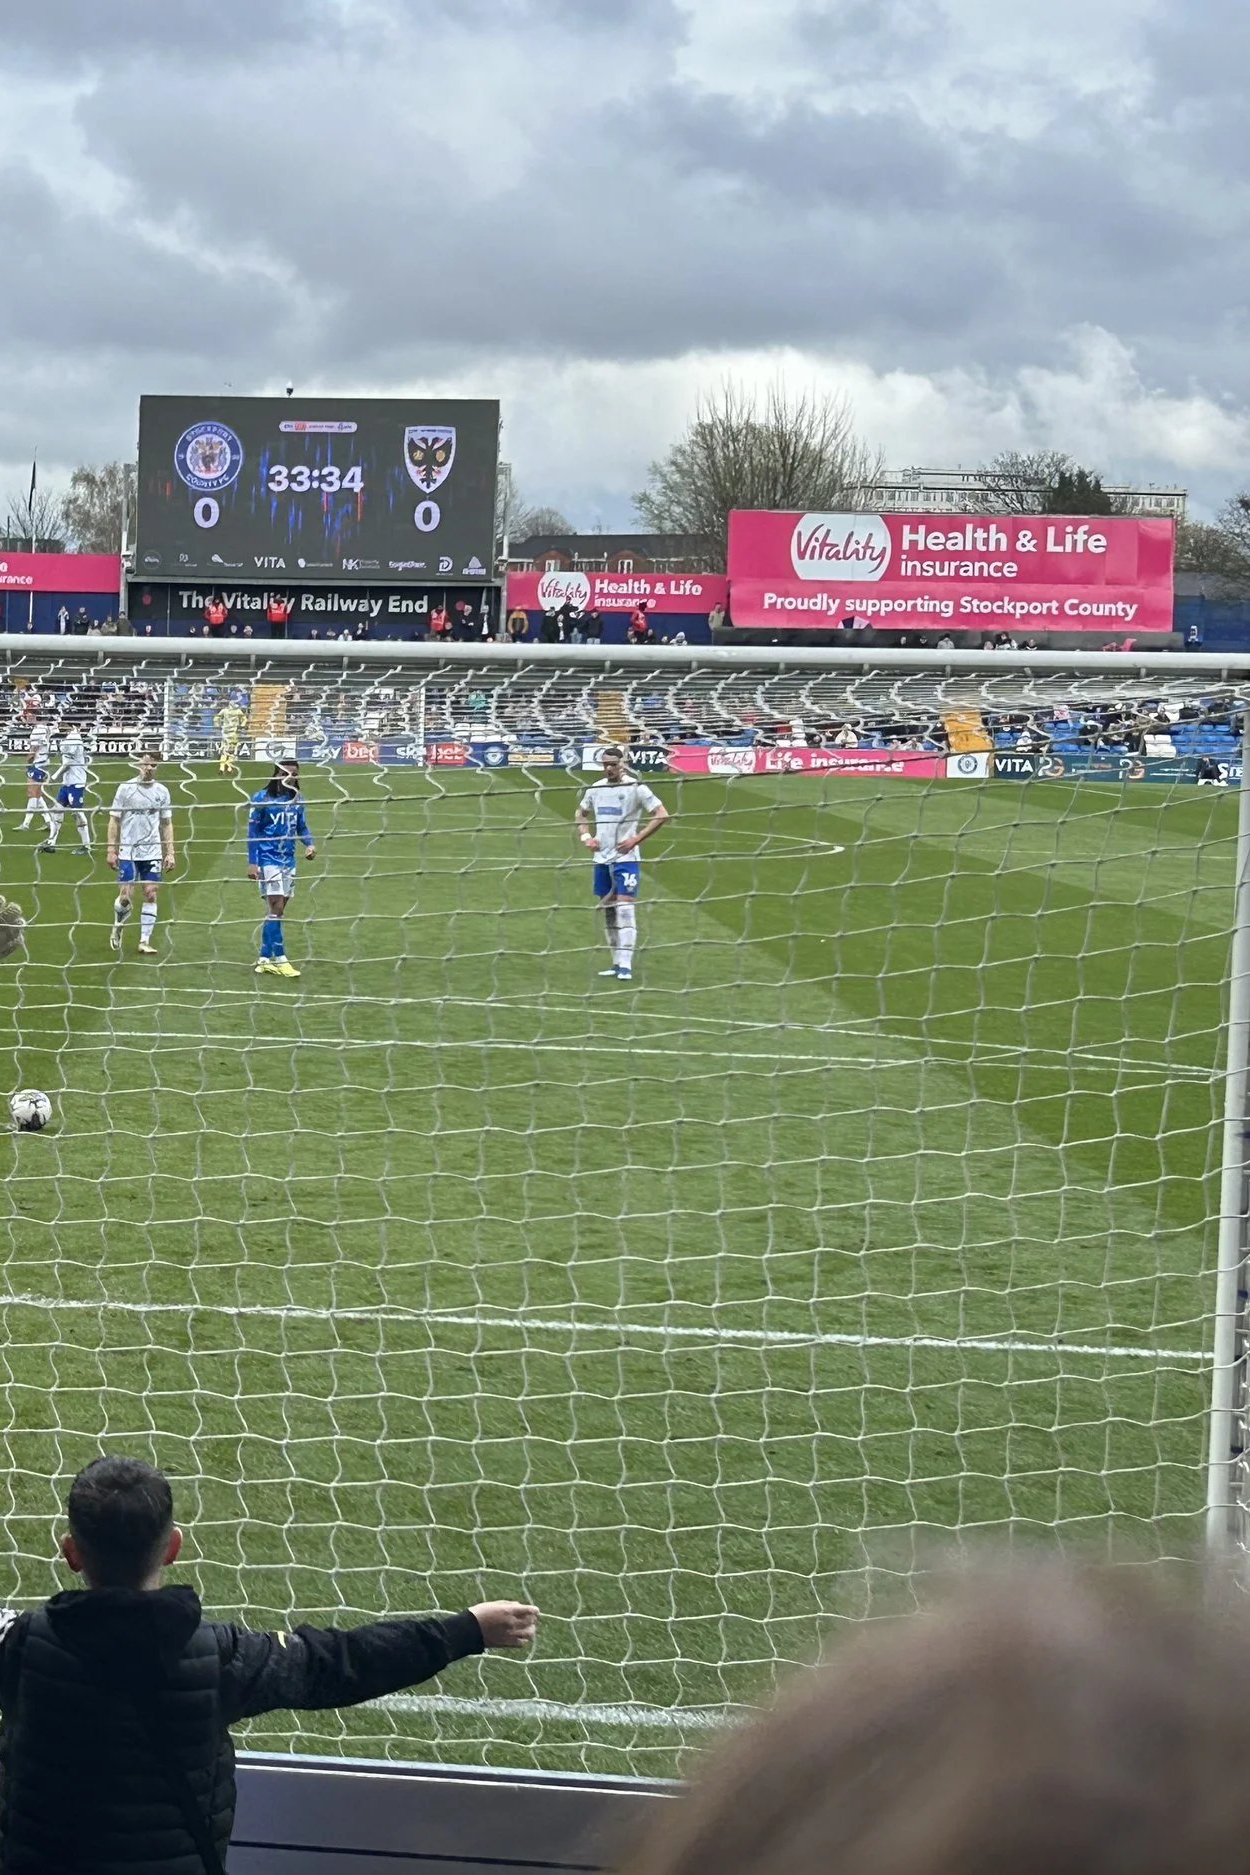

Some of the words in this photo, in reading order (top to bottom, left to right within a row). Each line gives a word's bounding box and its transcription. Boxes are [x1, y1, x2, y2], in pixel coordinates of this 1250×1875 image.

[267, 464, 365, 493] 33:34
[193, 497, 220, 528] 0
[413, 500, 441, 532] 0
[795, 523, 887, 573] Vitality
[901, 524, 1008, 552] Health
[1015, 529, 1038, 553] &
[1046, 525, 1107, 554] Life
[253, 556, 286, 569] VITA
[900, 554, 1018, 579] insurance
[540, 577, 588, 605] Vitality
[594, 578, 650, 594] Health
[653, 580, 666, 594] &
[670, 579, 702, 596] Life
[301, 593, 383, 618] Railway
[388, 595, 428, 613] End
[763, 592, 839, 614] Proudly
[845, 594, 951, 618] supporting
[959, 596, 1059, 619] Stockport
[1063, 598, 1138, 621] County
[628, 750, 668, 765] VITA
[765, 752, 804, 770] Life
[995, 758, 1034, 772] VITA
[621, 872, 638, 887] 16
